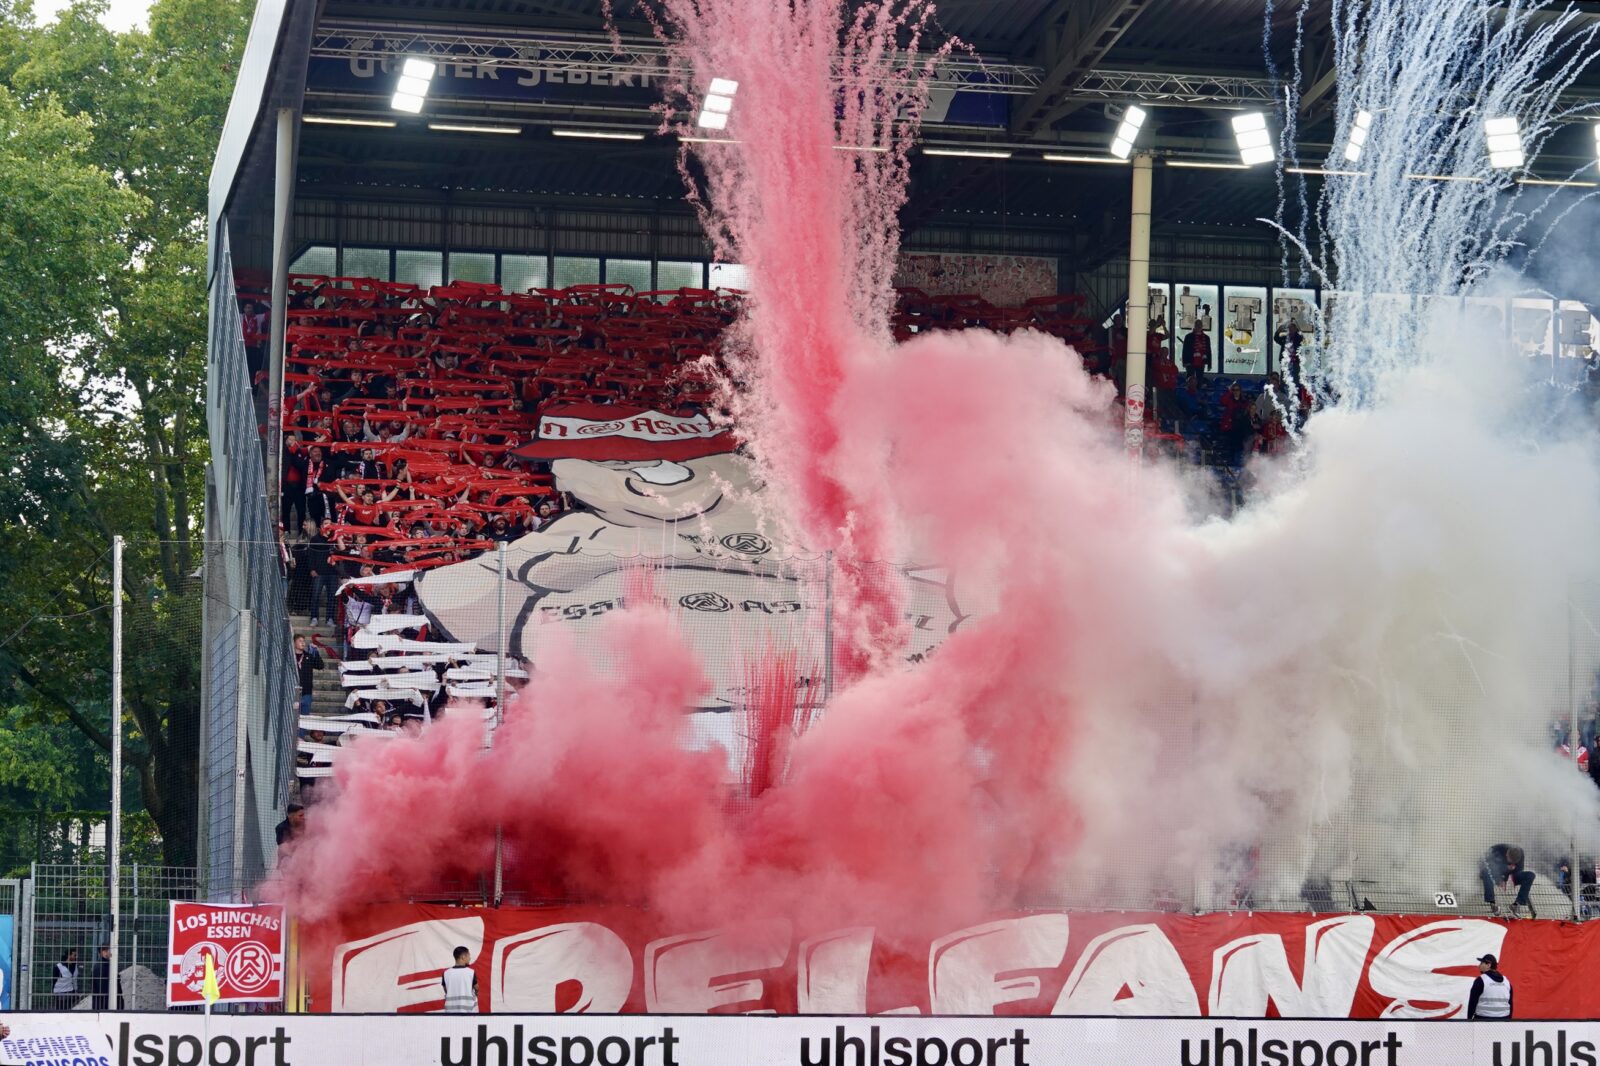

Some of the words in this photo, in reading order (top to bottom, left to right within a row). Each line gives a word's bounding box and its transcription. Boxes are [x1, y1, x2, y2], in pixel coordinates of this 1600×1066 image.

[1435, 894, 1454, 906] 26
[177, 913, 208, 932] LOS
[210, 911, 280, 931] HINCHAS
[206, 926, 251, 939] ESSEN
[3, 1035, 95, 1059] RECHNER
[104, 1022, 292, 1066] lsport
[441, 1024, 680, 1066] uhlsport
[800, 1025, 1030, 1066] uhlsport
[1181, 1027, 1403, 1066] uhlsport
